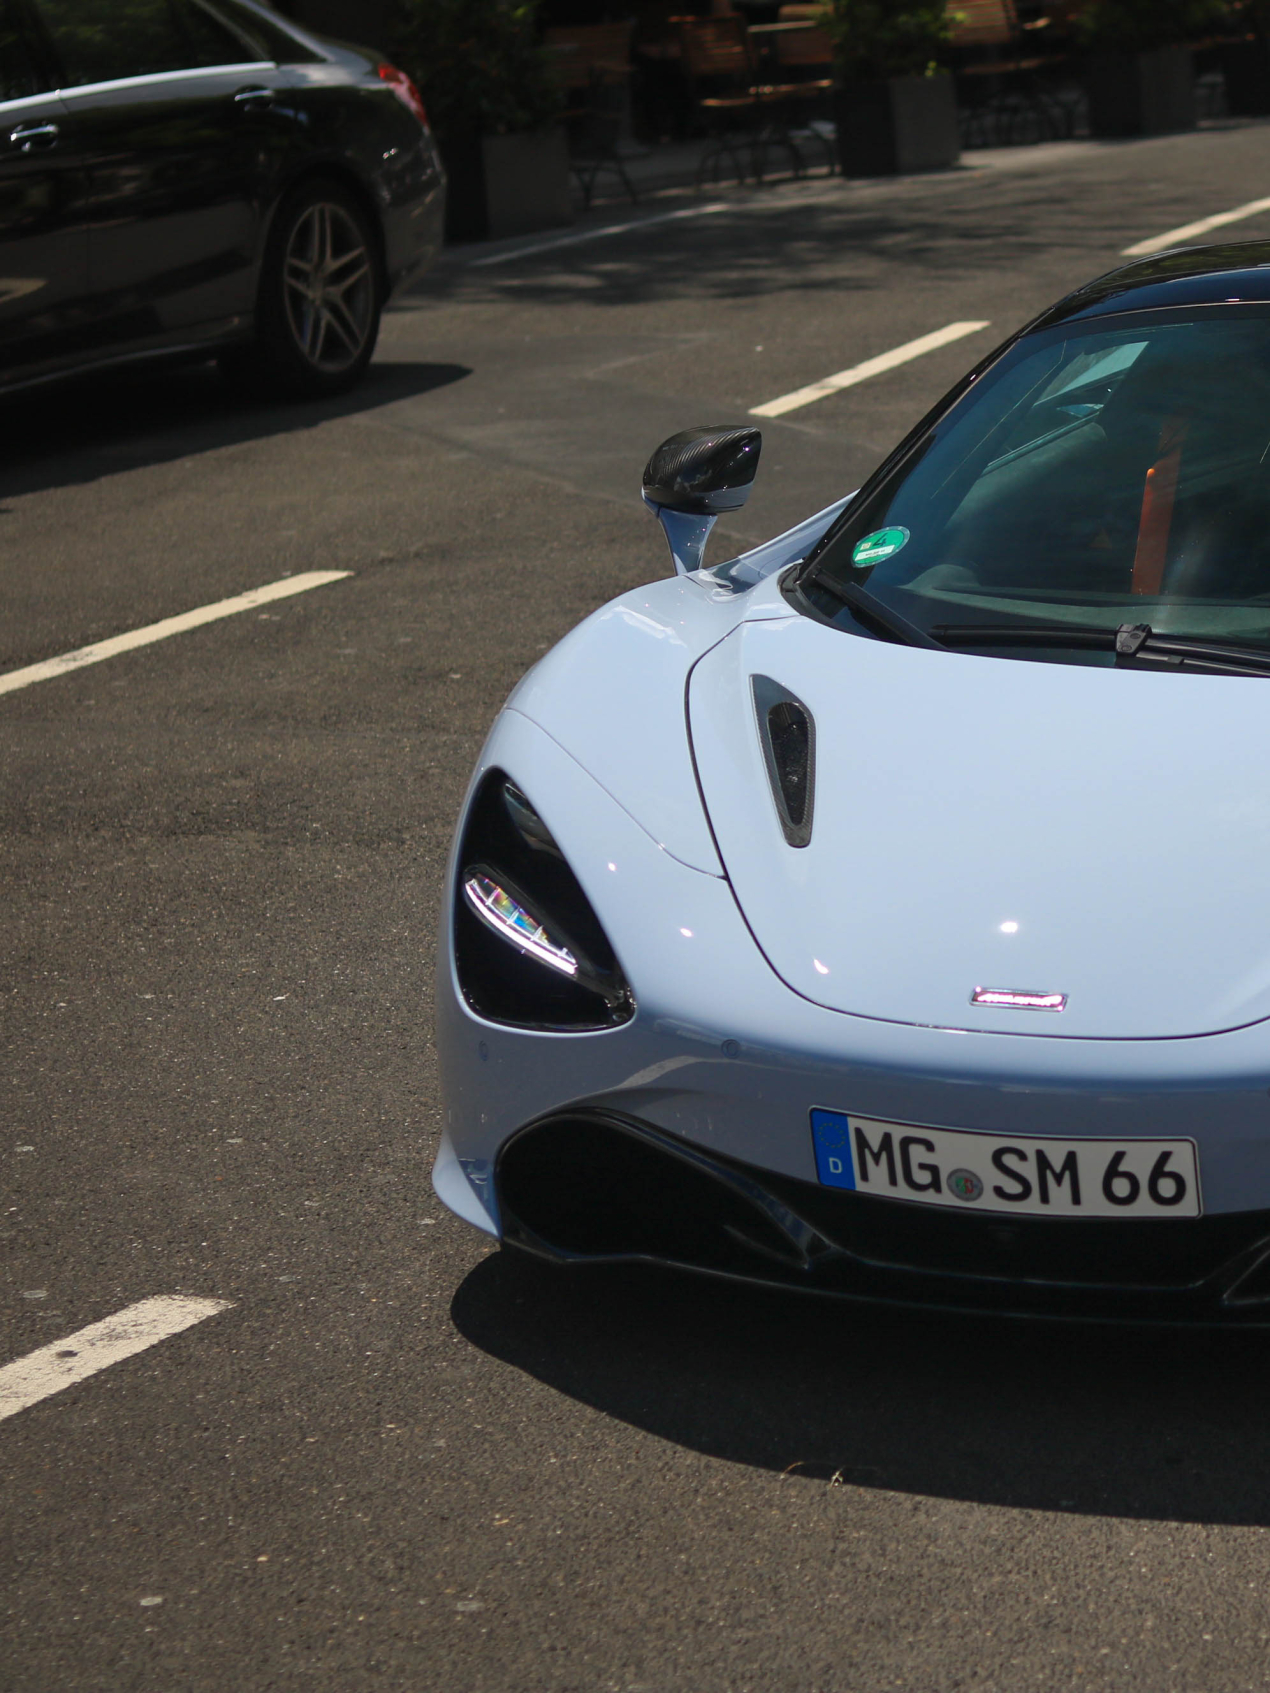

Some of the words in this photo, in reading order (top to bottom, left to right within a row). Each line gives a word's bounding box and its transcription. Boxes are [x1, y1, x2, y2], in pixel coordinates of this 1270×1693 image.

[829, 1157, 843, 1174] D
[854, 1126, 943, 1194] MG
[991, 1146, 1082, 1206] SM
[1101, 1150, 1187, 1207] 66
